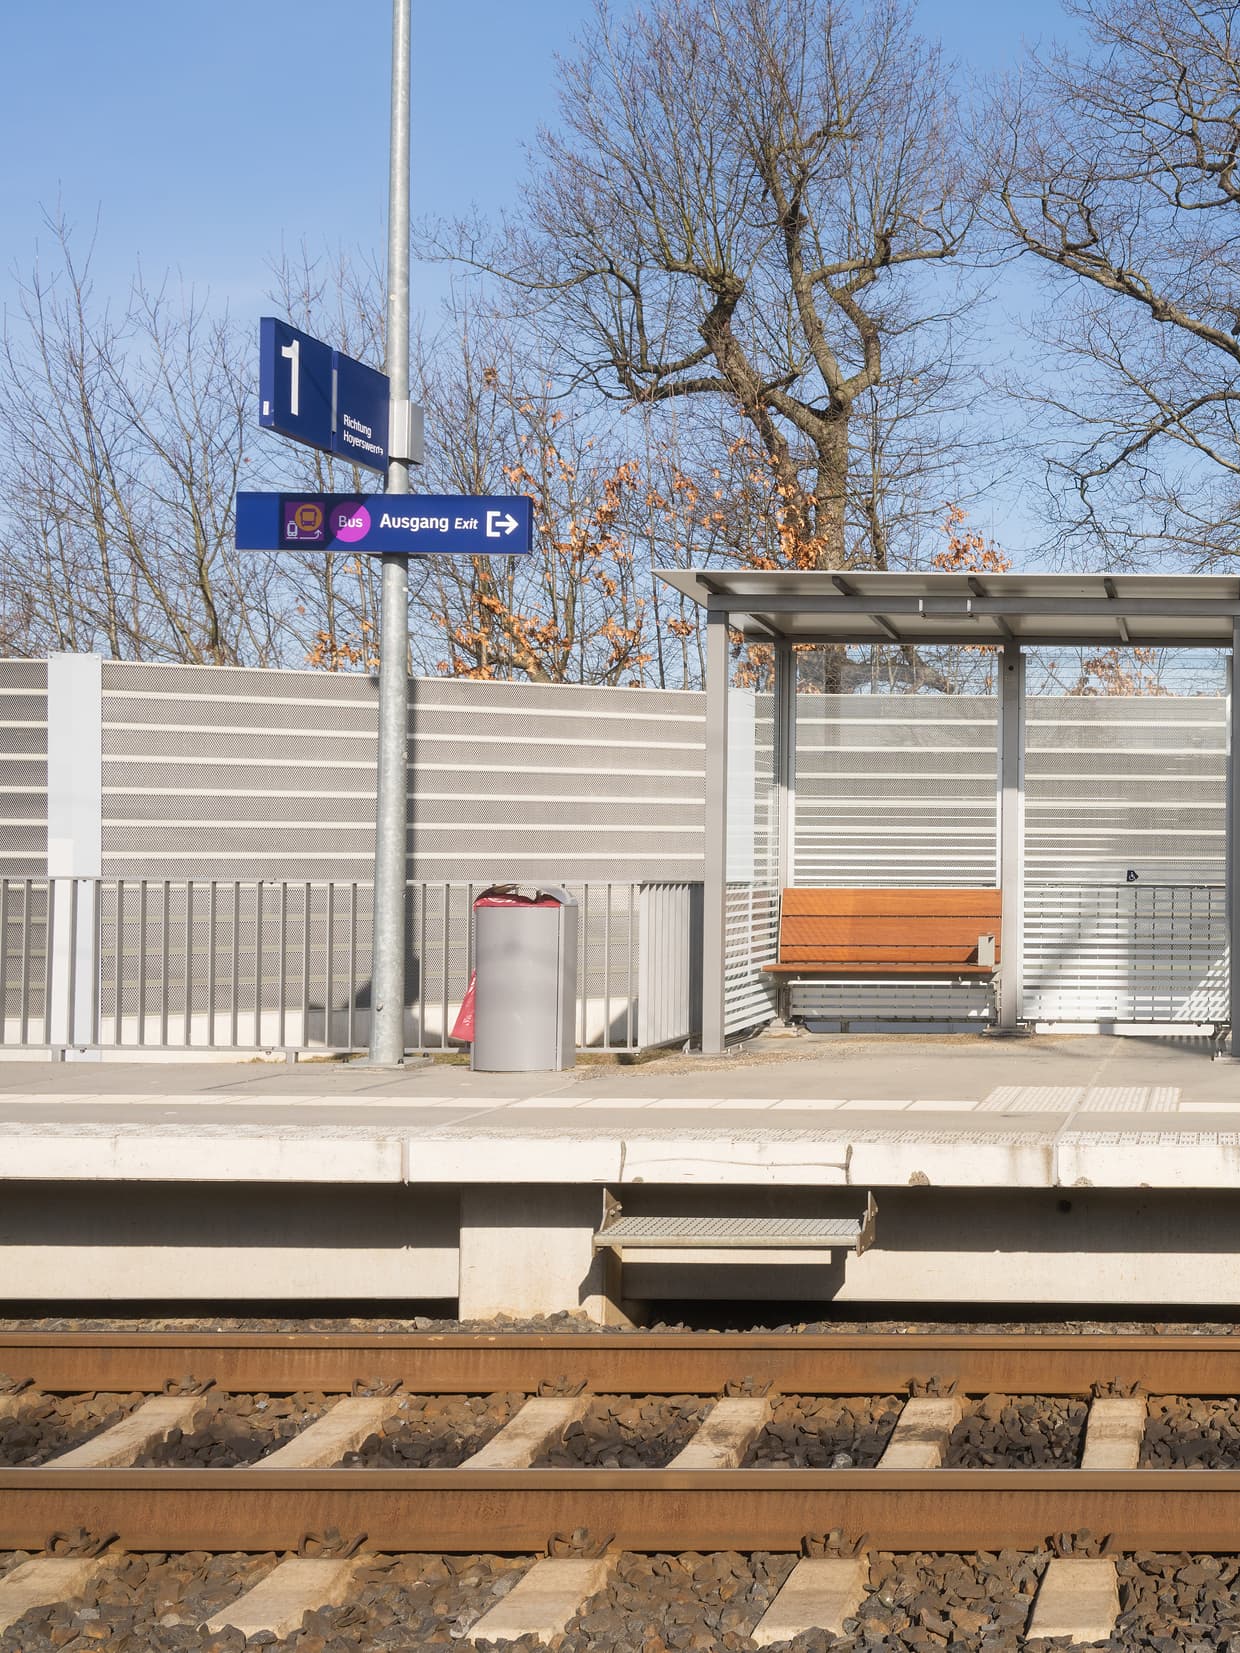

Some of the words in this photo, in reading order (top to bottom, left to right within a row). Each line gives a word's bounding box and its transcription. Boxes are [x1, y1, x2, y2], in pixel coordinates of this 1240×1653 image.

[281, 339, 300, 416] 1
[343, 414, 372, 439] Richtung
[338, 515, 363, 528] Bus
[379, 513, 450, 532] Ausgang
[454, 517, 478, 530] Exit
